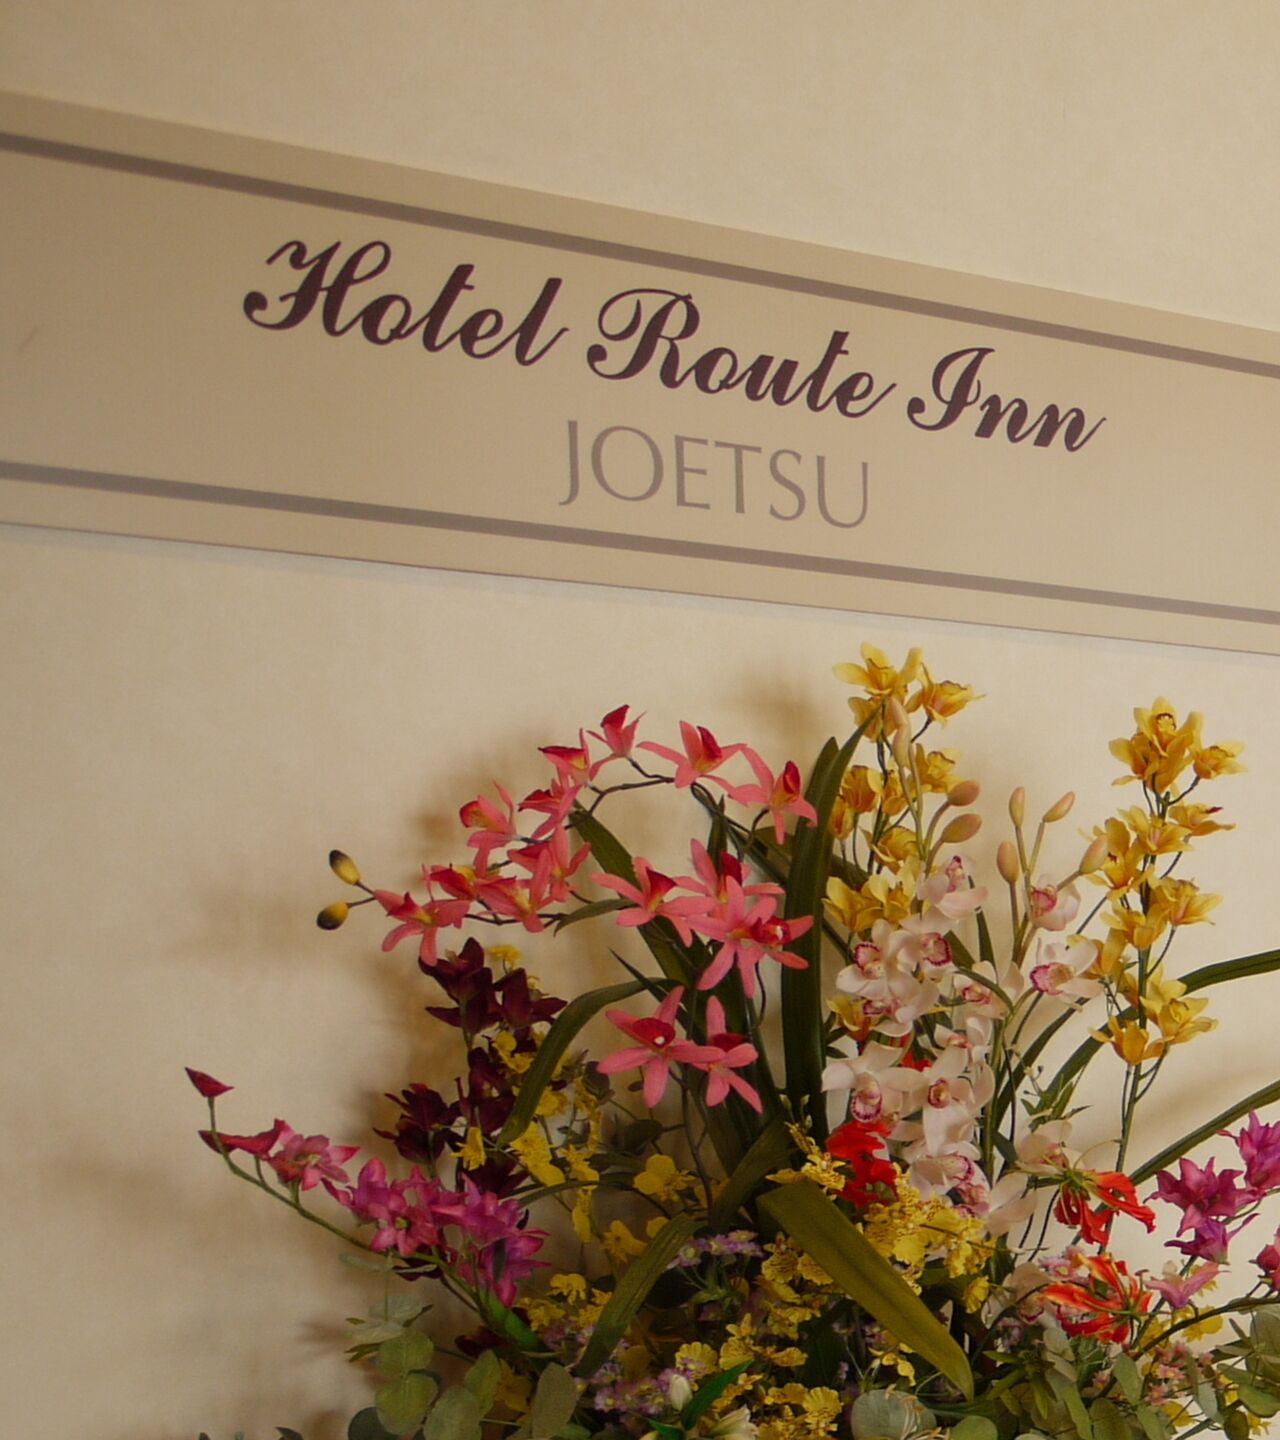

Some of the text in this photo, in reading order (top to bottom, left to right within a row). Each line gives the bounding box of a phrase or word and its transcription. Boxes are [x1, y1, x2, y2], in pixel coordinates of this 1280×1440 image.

[243, 240, 1107, 452] Hotel Route Inn
[559, 419, 870, 528] JOETSU
